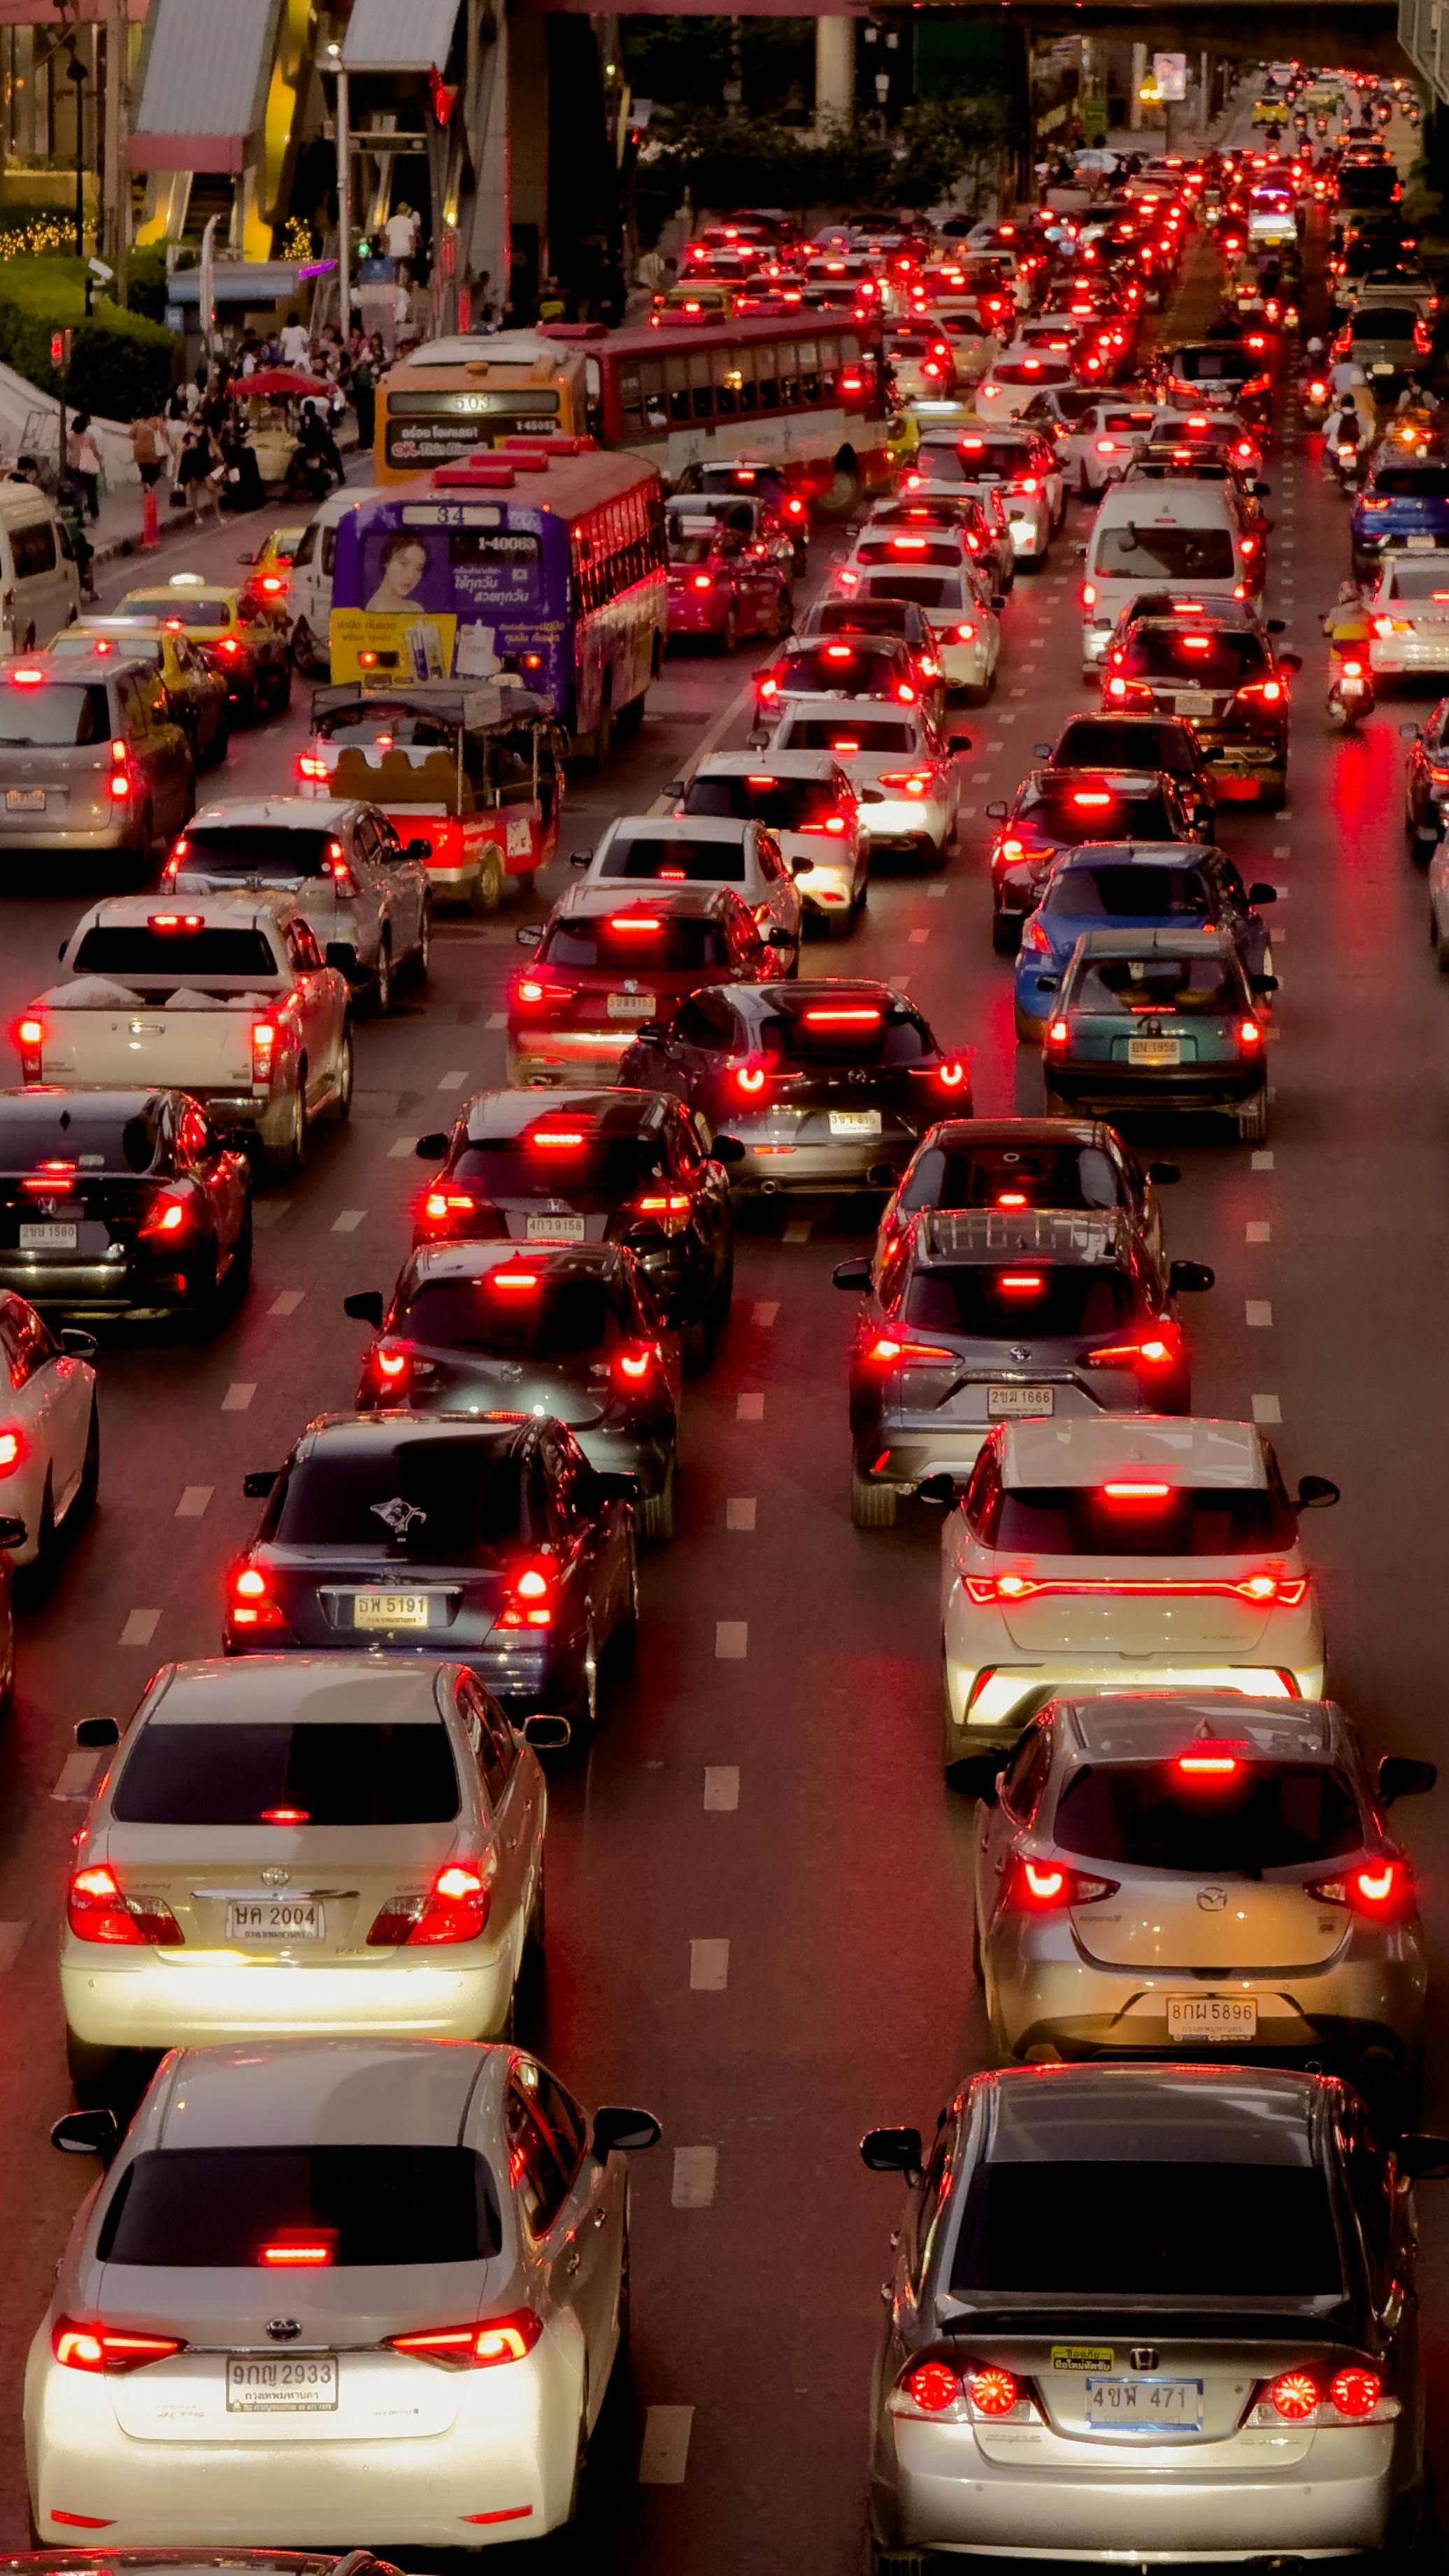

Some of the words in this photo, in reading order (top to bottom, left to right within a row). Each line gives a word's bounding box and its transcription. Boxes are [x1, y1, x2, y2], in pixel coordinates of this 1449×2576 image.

[456, 395, 490, 410] 503
[437, 506, 464, 523] 34
[1022, 1390, 1050, 1403] 1666
[386, 1597, 424, 1613] 5191
[269, 1906, 315, 1925] 2004
[1211, 2003, 1252, 2020] 5896
[281, 2364, 332, 2384] 2933
[1150, 2386, 1185, 2407] 471
